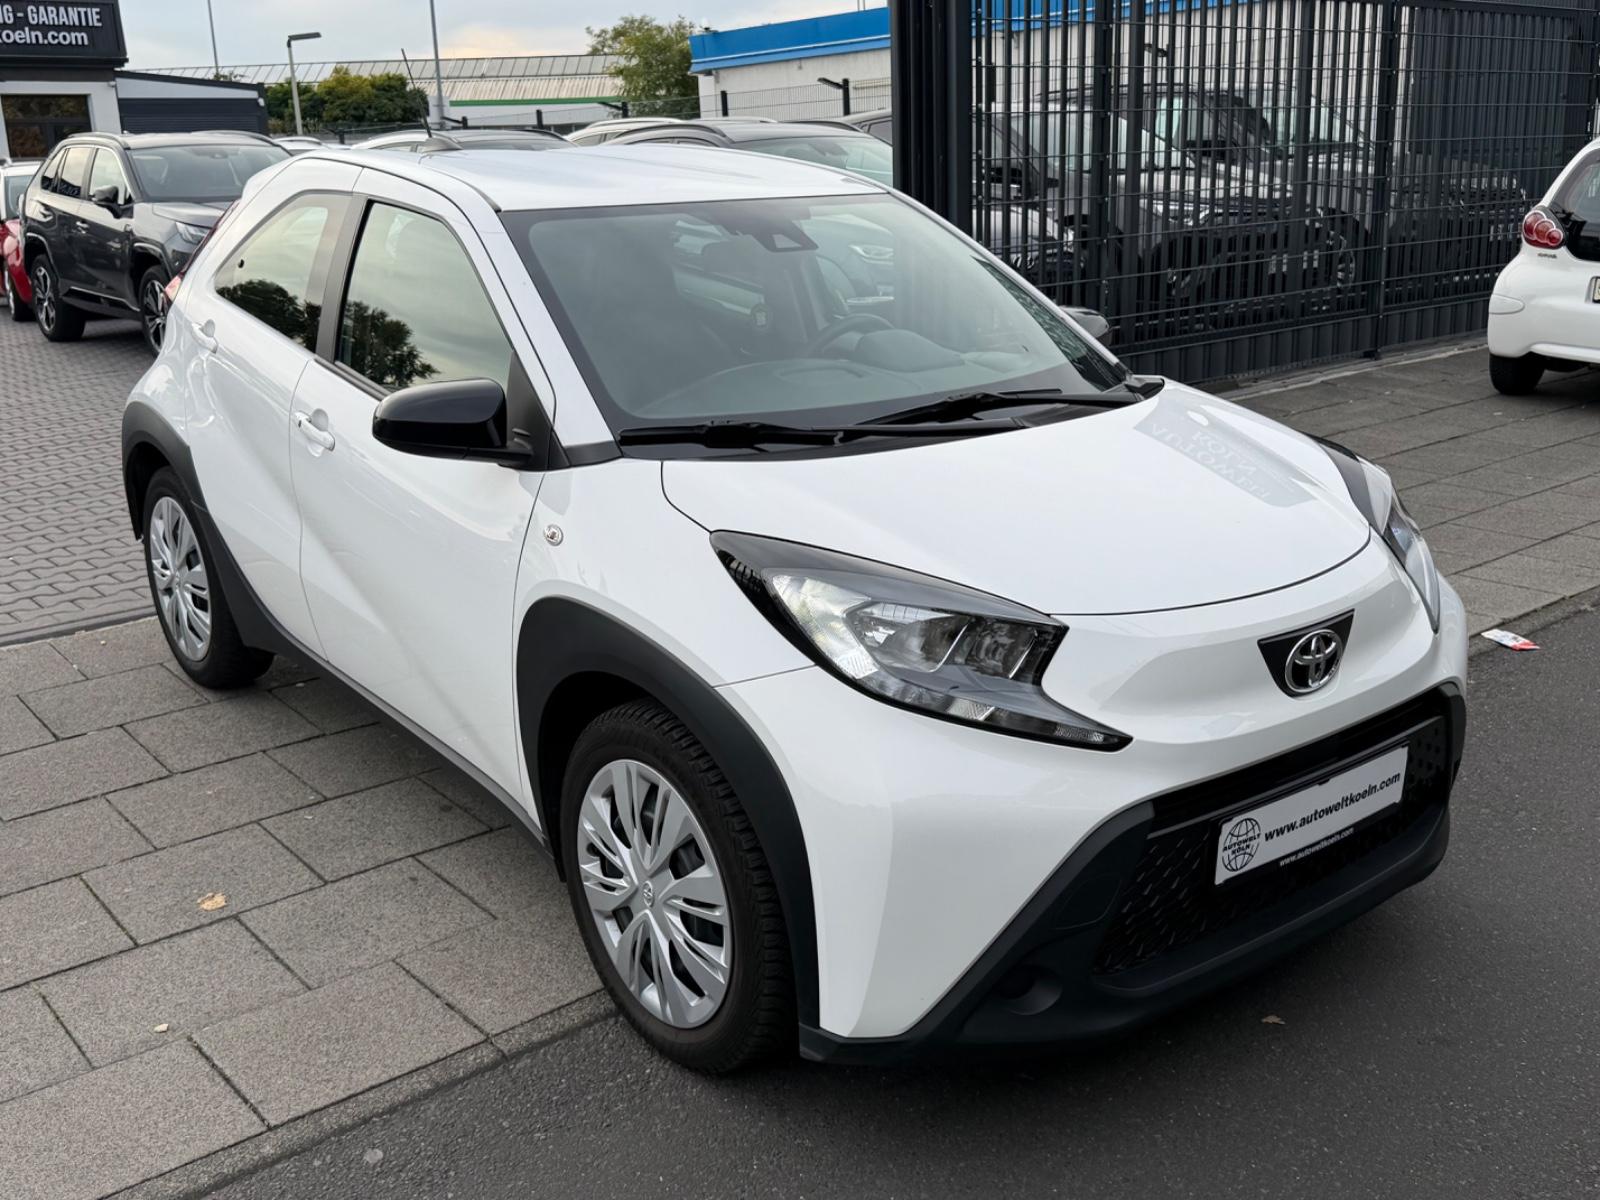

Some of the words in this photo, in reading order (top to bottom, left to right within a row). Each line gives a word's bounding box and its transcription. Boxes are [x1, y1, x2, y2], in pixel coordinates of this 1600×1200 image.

[27, 5, 102, 27] GARANTIE
[0, 27, 88, 45] oeln.com
[1264, 772, 1401, 842] www.autoweltkoeln.com
[1222, 833, 1261, 852] AUTOWELT
